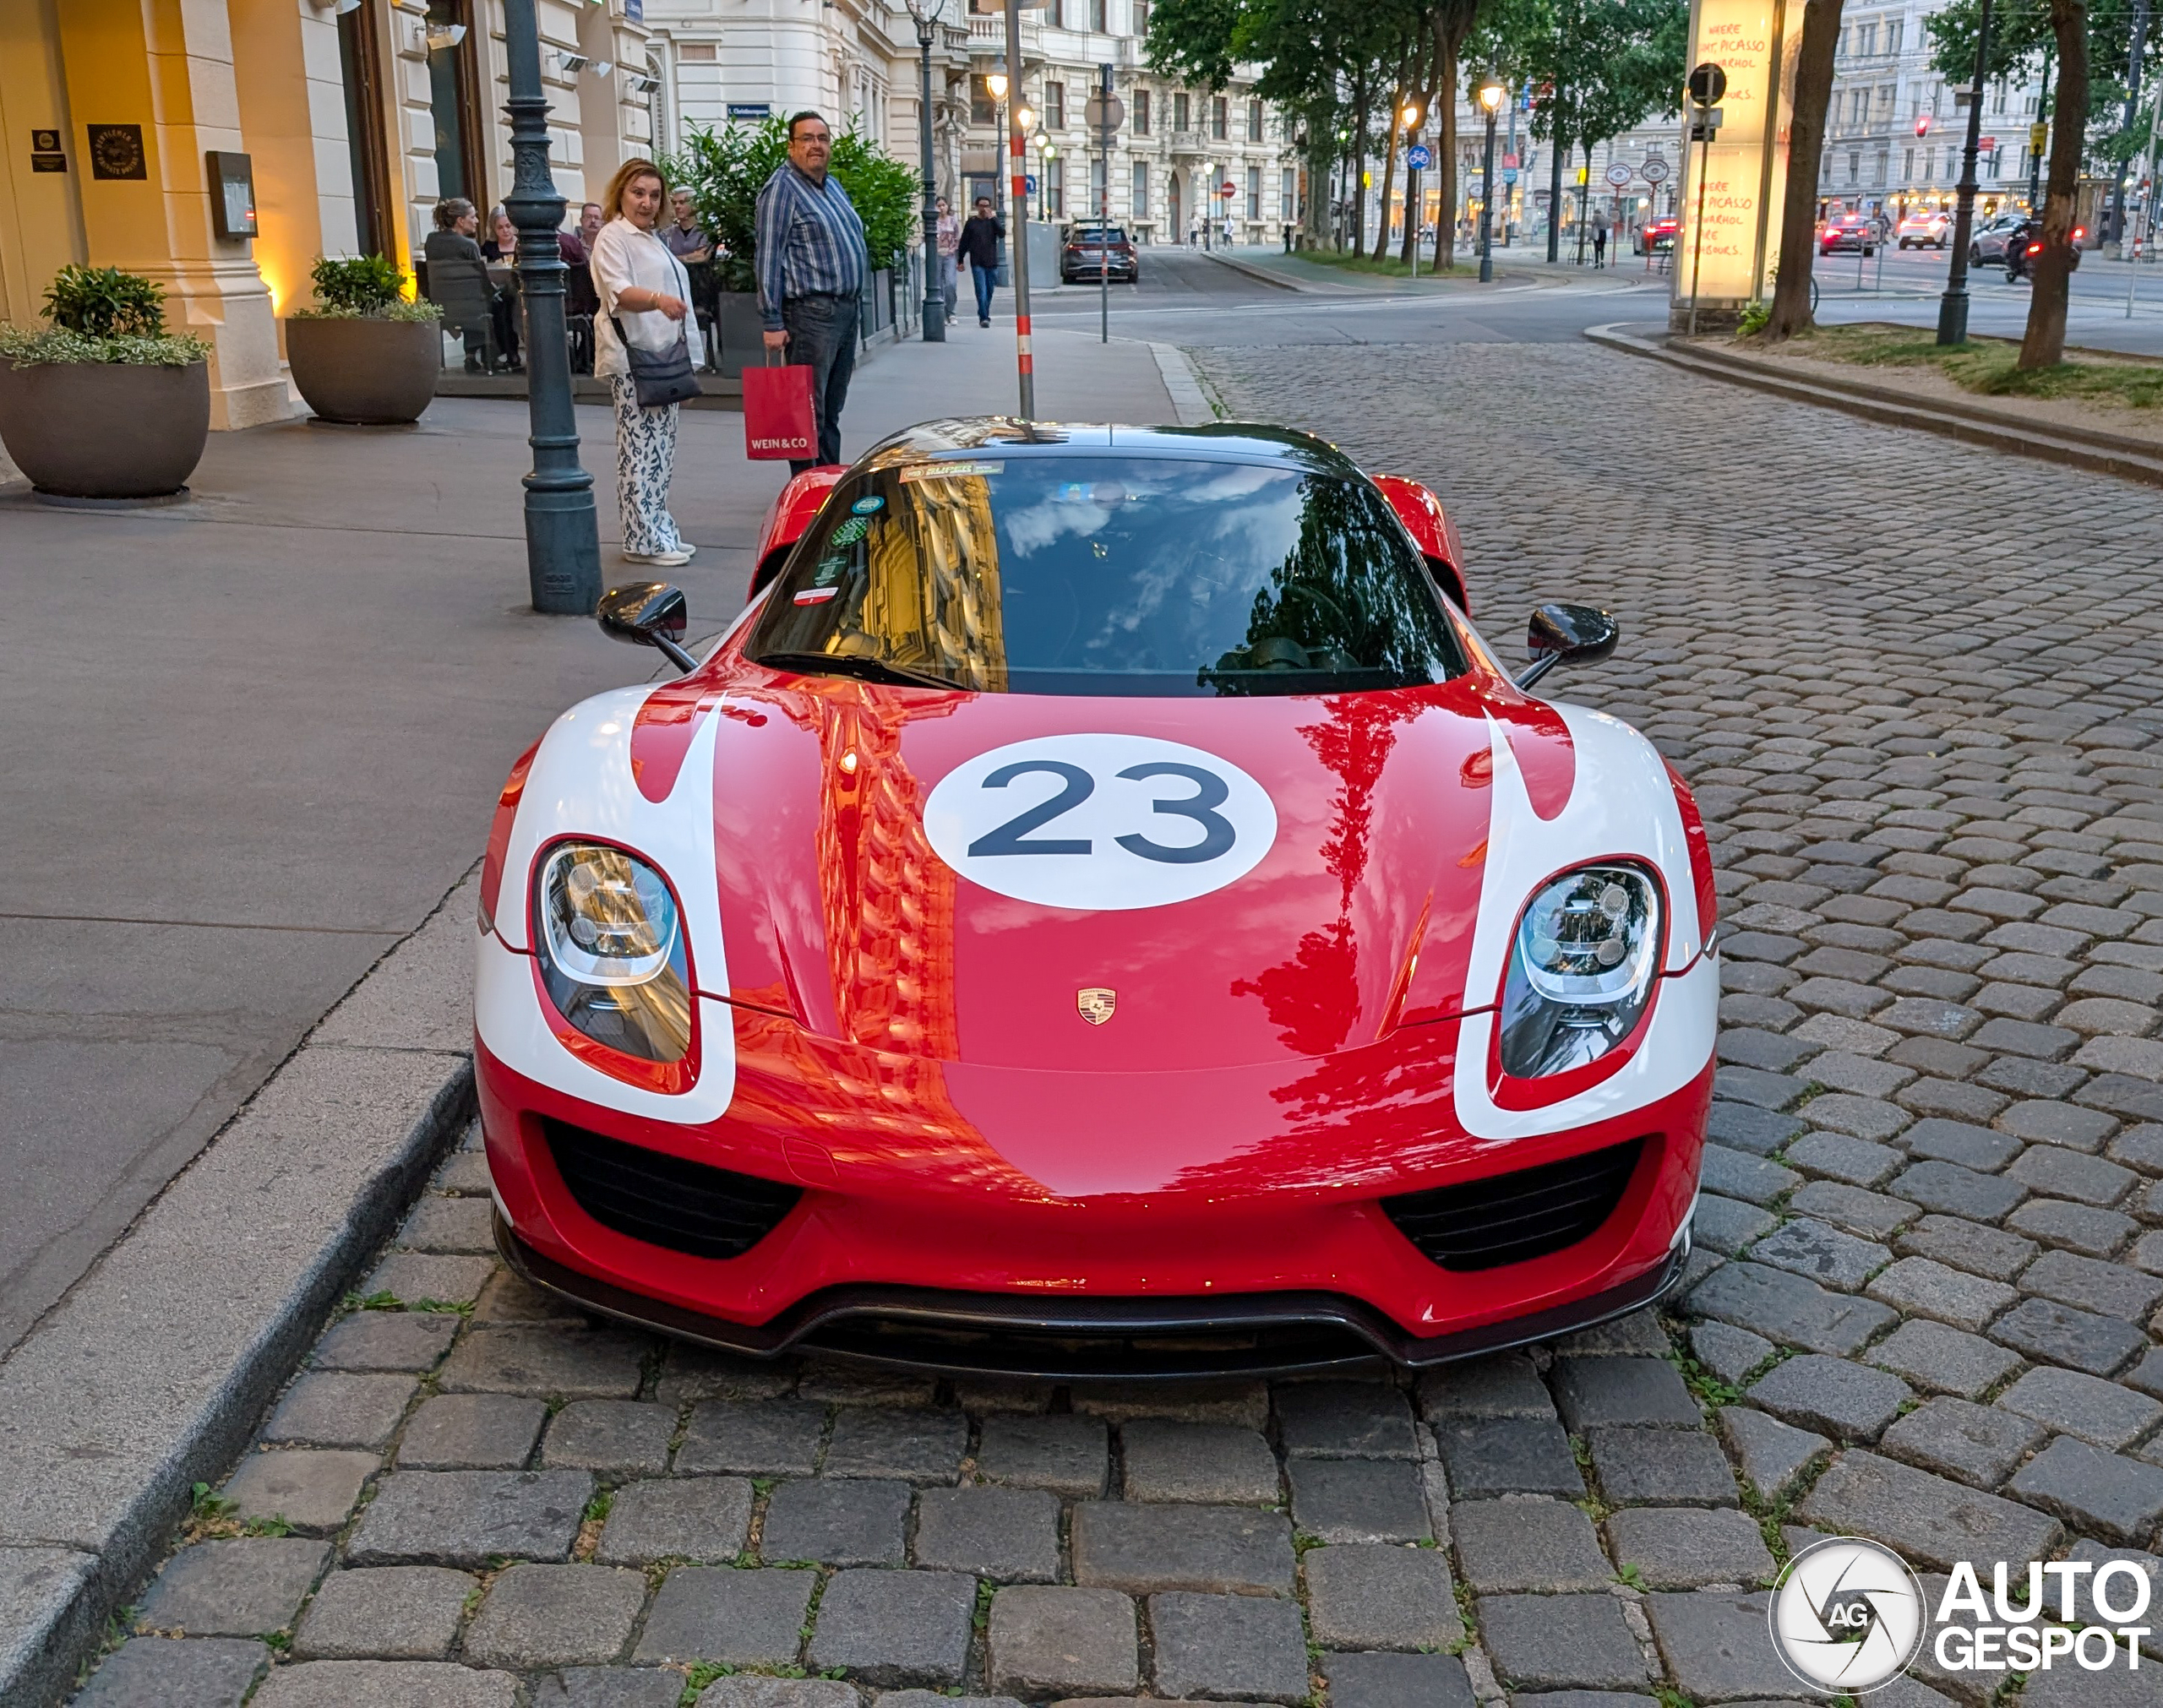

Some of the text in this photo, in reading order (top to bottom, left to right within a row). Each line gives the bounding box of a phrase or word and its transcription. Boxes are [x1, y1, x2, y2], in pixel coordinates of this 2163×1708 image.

[1708, 24, 1741, 35] WHERE
[1720, 40, 1765, 52] PICASSO
[1699, 181, 1730, 193] ERE
[1708, 198, 1752, 209] PICASSO
[751, 438, 808, 449] WEIN & CO
[967, 759, 1237, 864] 23
